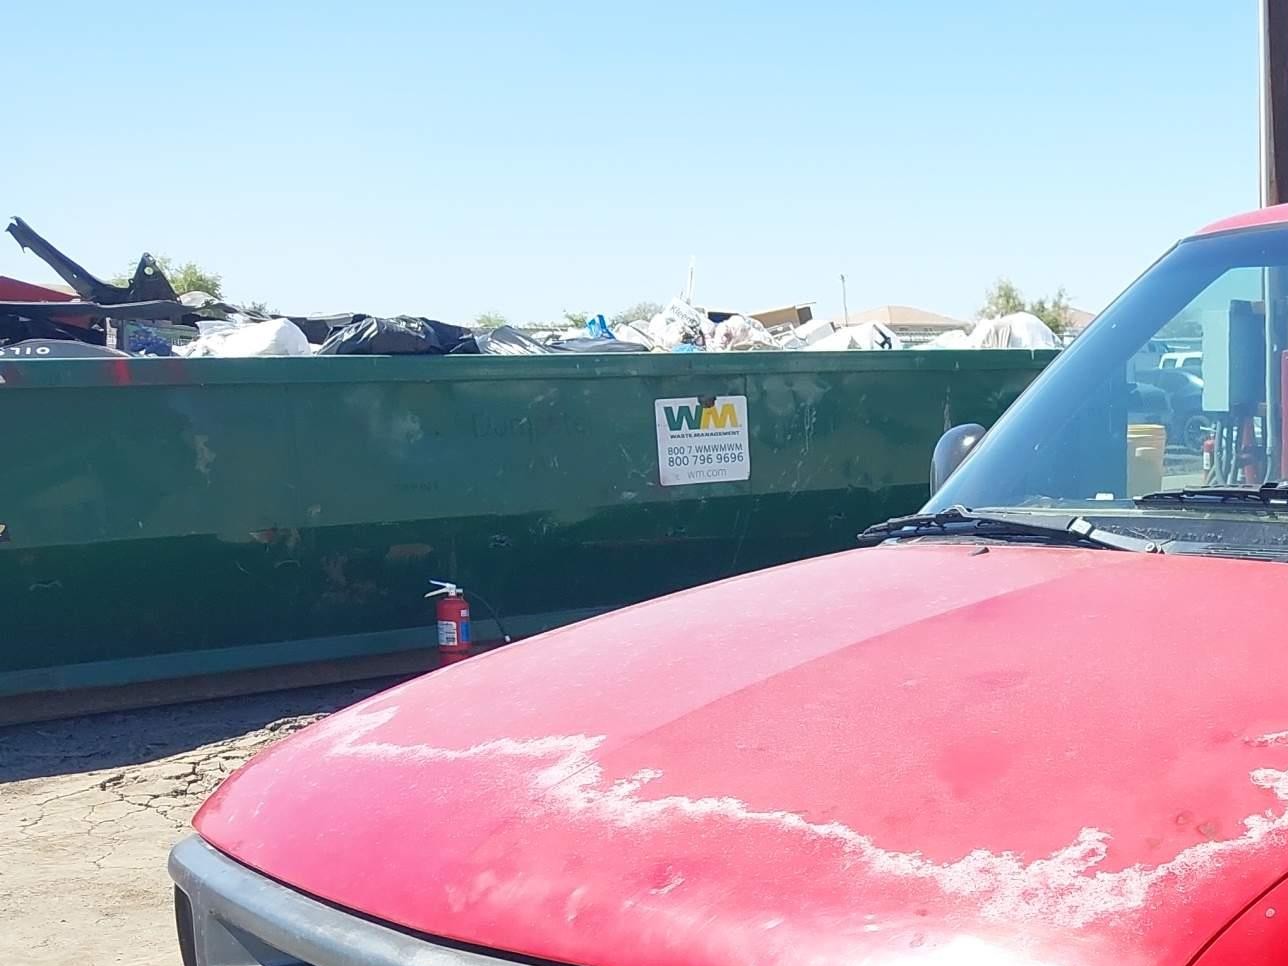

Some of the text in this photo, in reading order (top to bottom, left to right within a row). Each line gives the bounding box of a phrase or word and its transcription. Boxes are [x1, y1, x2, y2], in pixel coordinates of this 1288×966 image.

[663, 403, 739, 432] WM
[693, 430, 740, 438] MANAGEMENT
[668, 446, 685, 456] 800
[687, 445, 692, 454] 7
[668, 451, 744, 467] 800 796 9696
[688, 468, 727, 479] wm.com
